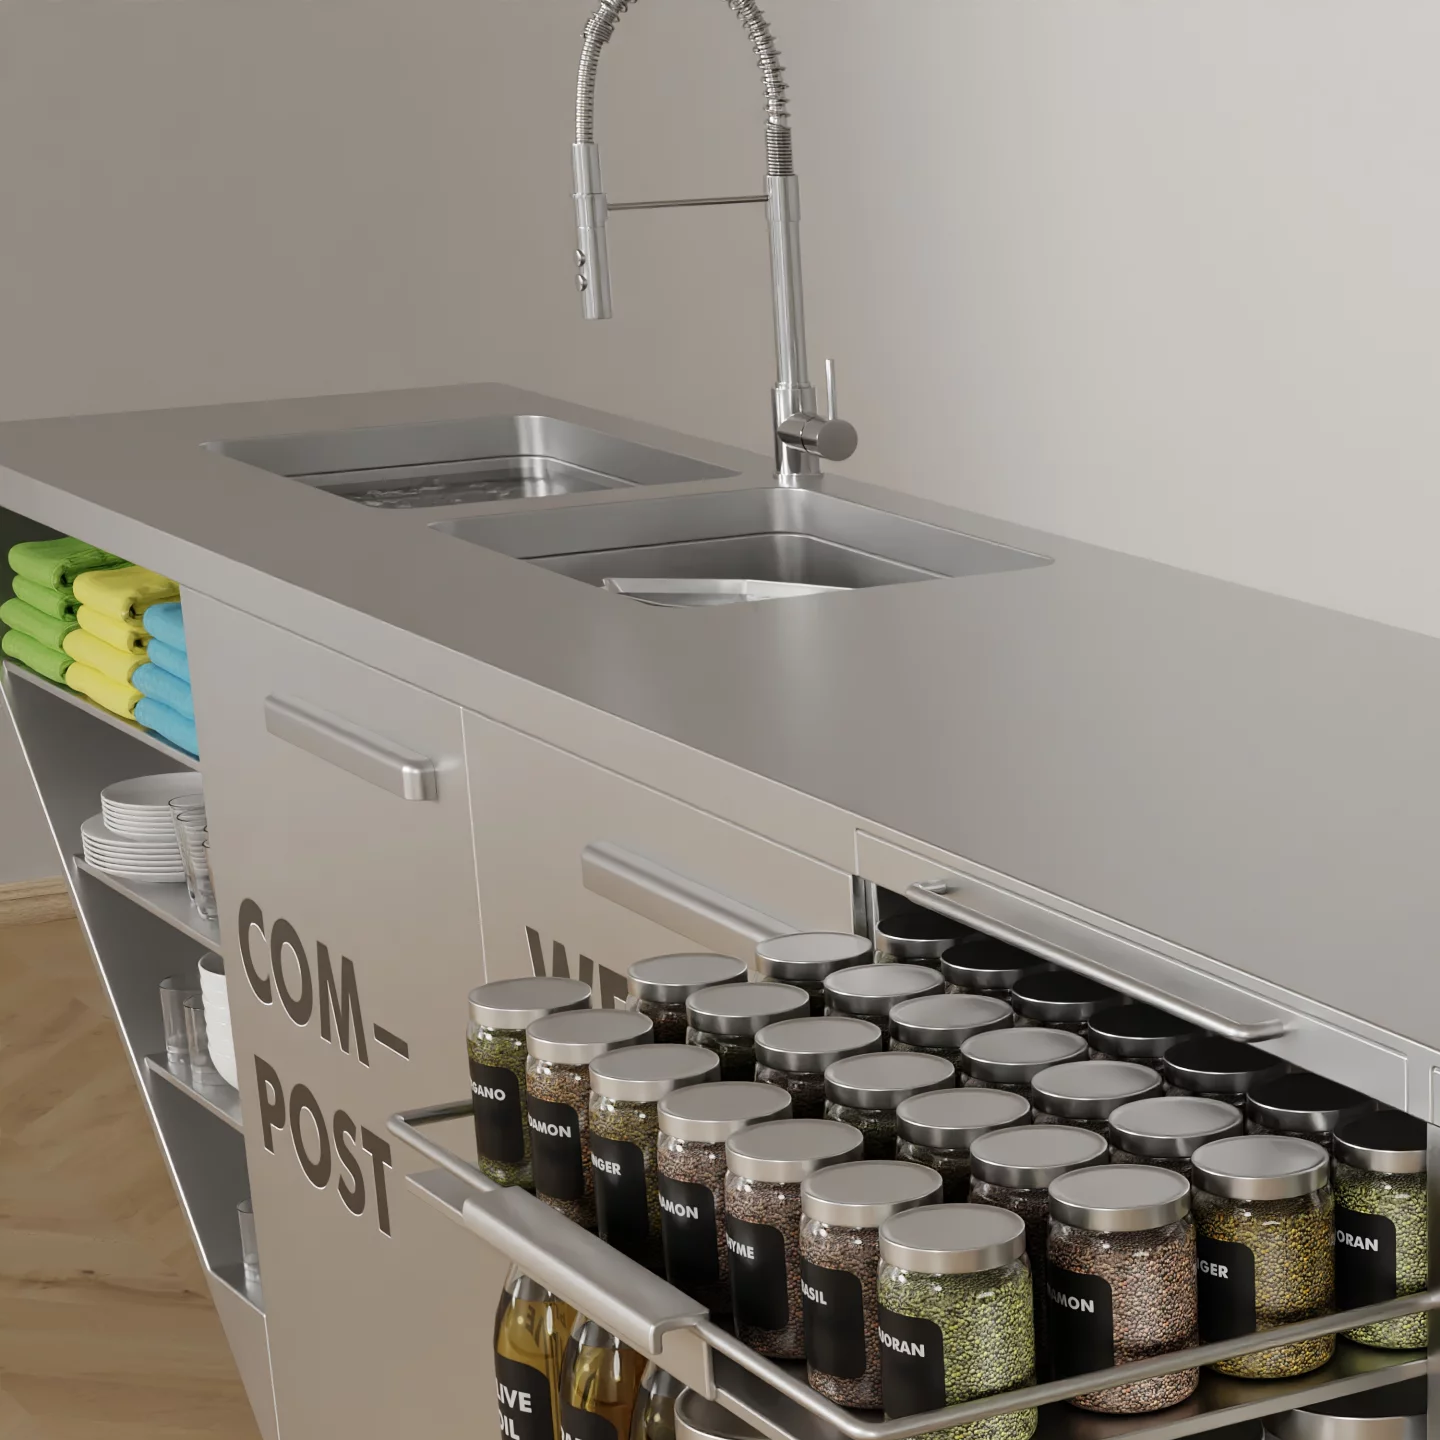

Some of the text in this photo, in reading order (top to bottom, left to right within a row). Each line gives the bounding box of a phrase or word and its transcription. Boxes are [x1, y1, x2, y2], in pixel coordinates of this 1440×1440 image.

[238, 897, 409, 1068] COM-
[471, 1080, 507, 1102] GANO
[527, 1111, 572, 1138] DAMON
[253, 1054, 393, 1239] POST
[1335, 1229, 1379, 1252] ORAN
[1196, 1257, 1229, 1279] GER
[495, 1377, 533, 1414] LIVE
